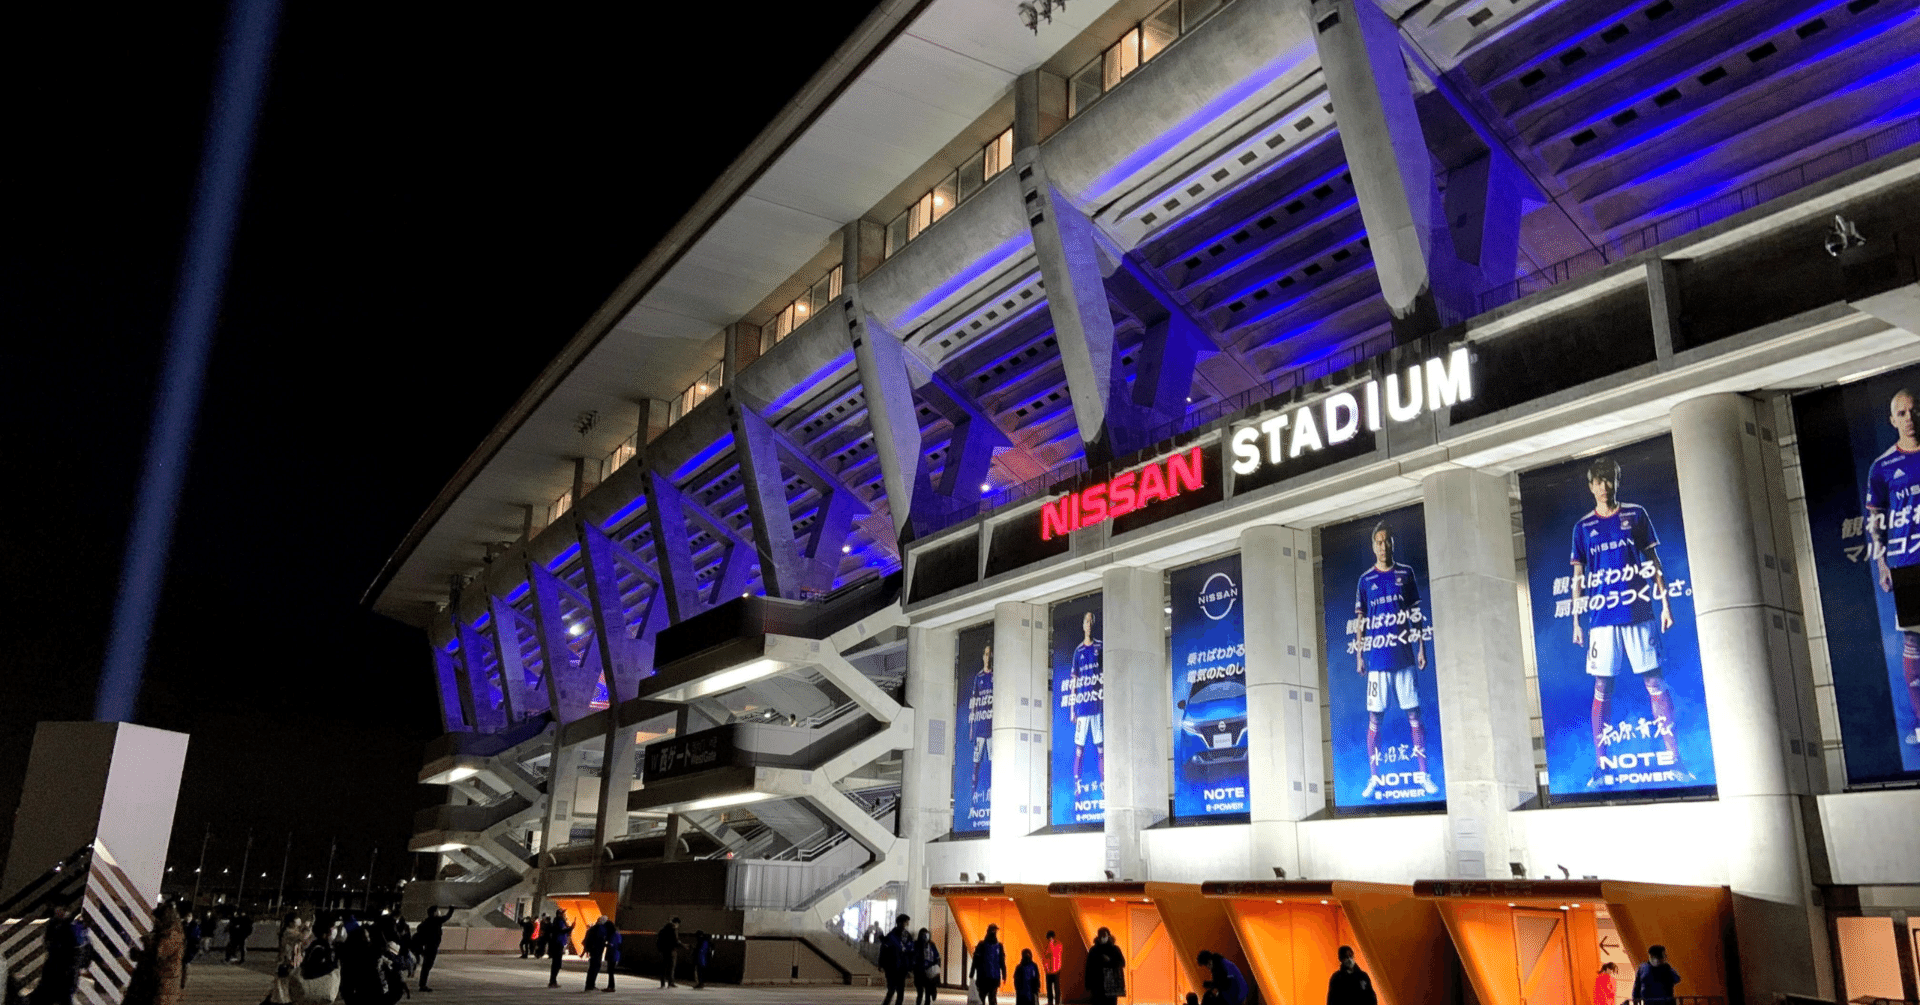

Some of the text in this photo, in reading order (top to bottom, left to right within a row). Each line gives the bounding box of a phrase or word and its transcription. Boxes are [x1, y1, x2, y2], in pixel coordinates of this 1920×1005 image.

[1041, 346, 1473, 541] NISSAN STADIUM
[1590, 537, 1635, 555] NISSAN
[1553, 560, 1662, 596] 観ればわかる、
[1197, 587, 1239, 605] NISSAN
[1554, 578, 1693, 618] 扇原のうつくしさ。
[1599, 751, 1675, 770] NOTE
[1371, 771, 1426, 787] NOTE
[1204, 786, 1245, 801] NOTE
